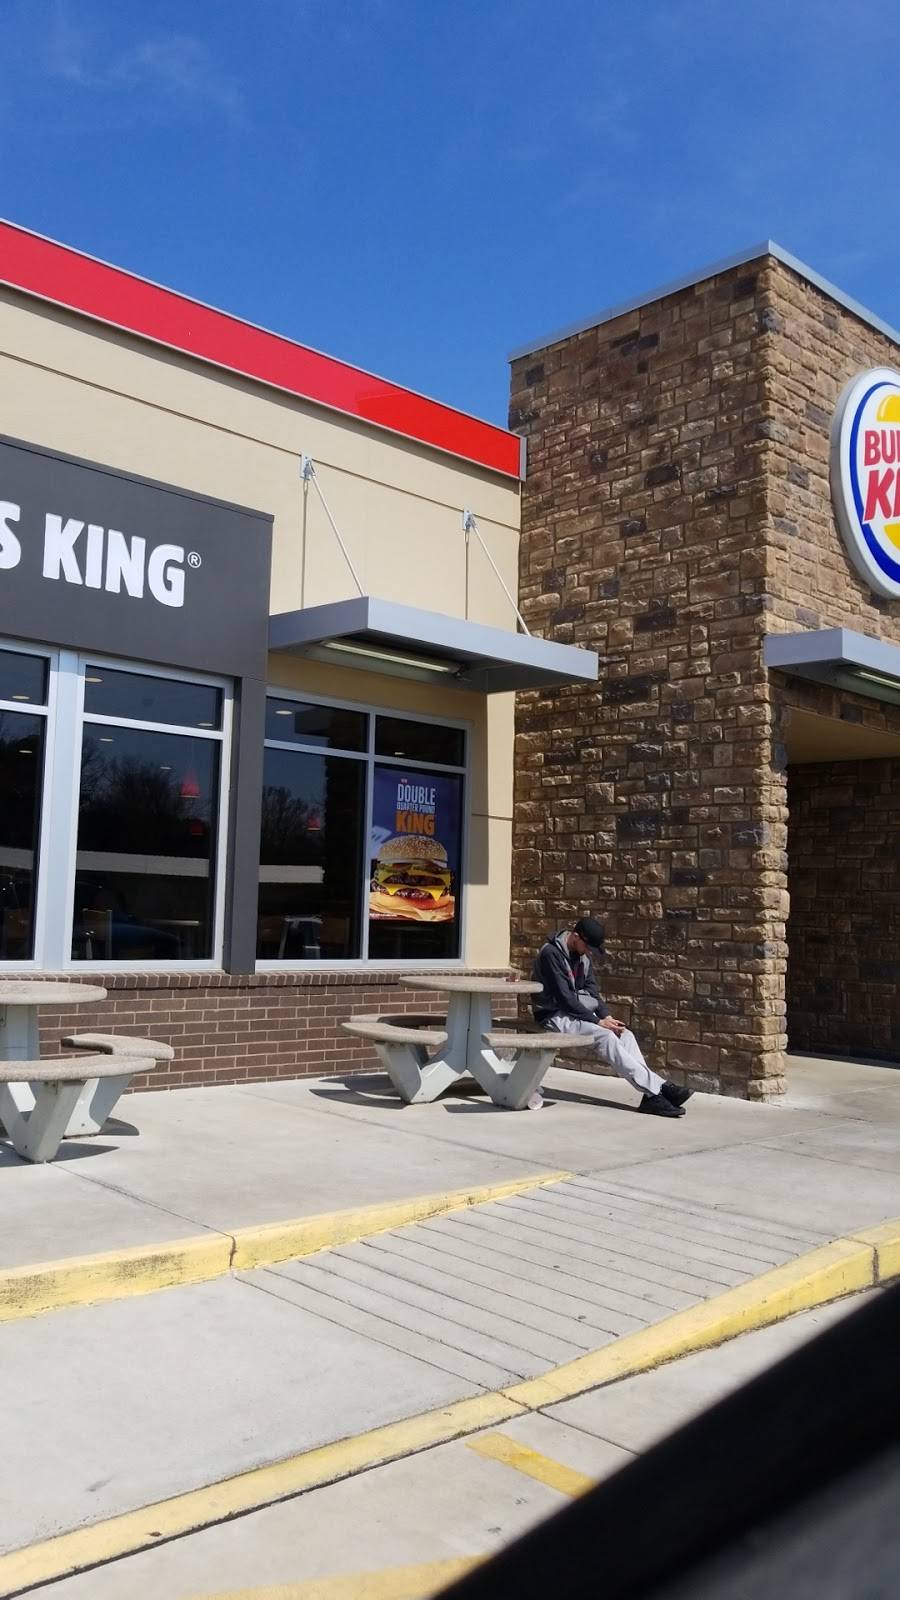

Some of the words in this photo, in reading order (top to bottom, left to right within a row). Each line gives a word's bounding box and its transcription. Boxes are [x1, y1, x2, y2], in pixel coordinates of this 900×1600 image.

[864, 429, 900, 466] BU
[397, 783, 436, 806] DOUBLE
[395, 810, 435, 836] KING
